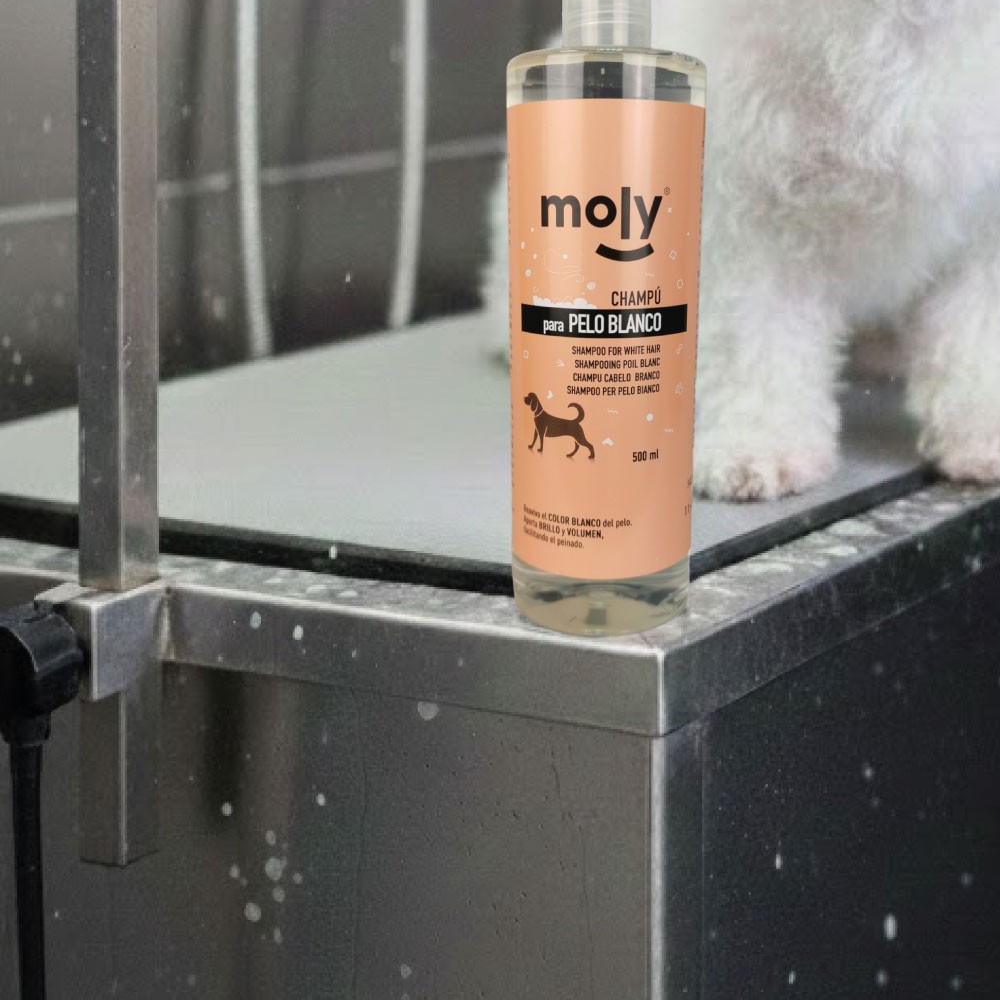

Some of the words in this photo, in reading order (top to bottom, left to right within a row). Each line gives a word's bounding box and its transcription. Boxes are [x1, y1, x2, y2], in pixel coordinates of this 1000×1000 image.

[611, 286, 661, 307] CHAMPÚ
[543, 319, 564, 334] para
[568, 313, 605, 334] PELO
[608, 312, 662, 334] BLANCO
[571, 345, 606, 356] SHAMPOO
[608, 346, 622, 356] FOR
[623, 345, 645, 356] WHITE
[646, 344, 661, 354] HAIR
[574, 359, 621, 370] SHAMPOOING
[623, 359, 639, 369] POIL
[640, 357, 661, 368] BLANC
[572, 372, 603, 383] CHAMPU
[604, 372, 631, 383] CABELO
[634, 370, 660, 382] BRANCO
[566, 385, 601, 396] SHAMPOO
[602, 386, 617, 396] PER
[618, 385, 635, 395] PELO
[637, 383, 660, 395] BIANCO
[632, 451, 647, 463] 500
[649, 448, 659, 460] ml
[541, 511, 547, 520] el
[548, 513, 570, 525] COLOR
[571, 516, 601, 528] BLANCO
[602, 518, 614, 528] del
[615, 518, 633, 529] pelo.
[538, 521, 561, 534] BRILLO
[566, 527, 604, 540] VOLUMEN,
[549, 536, 556, 544] el
